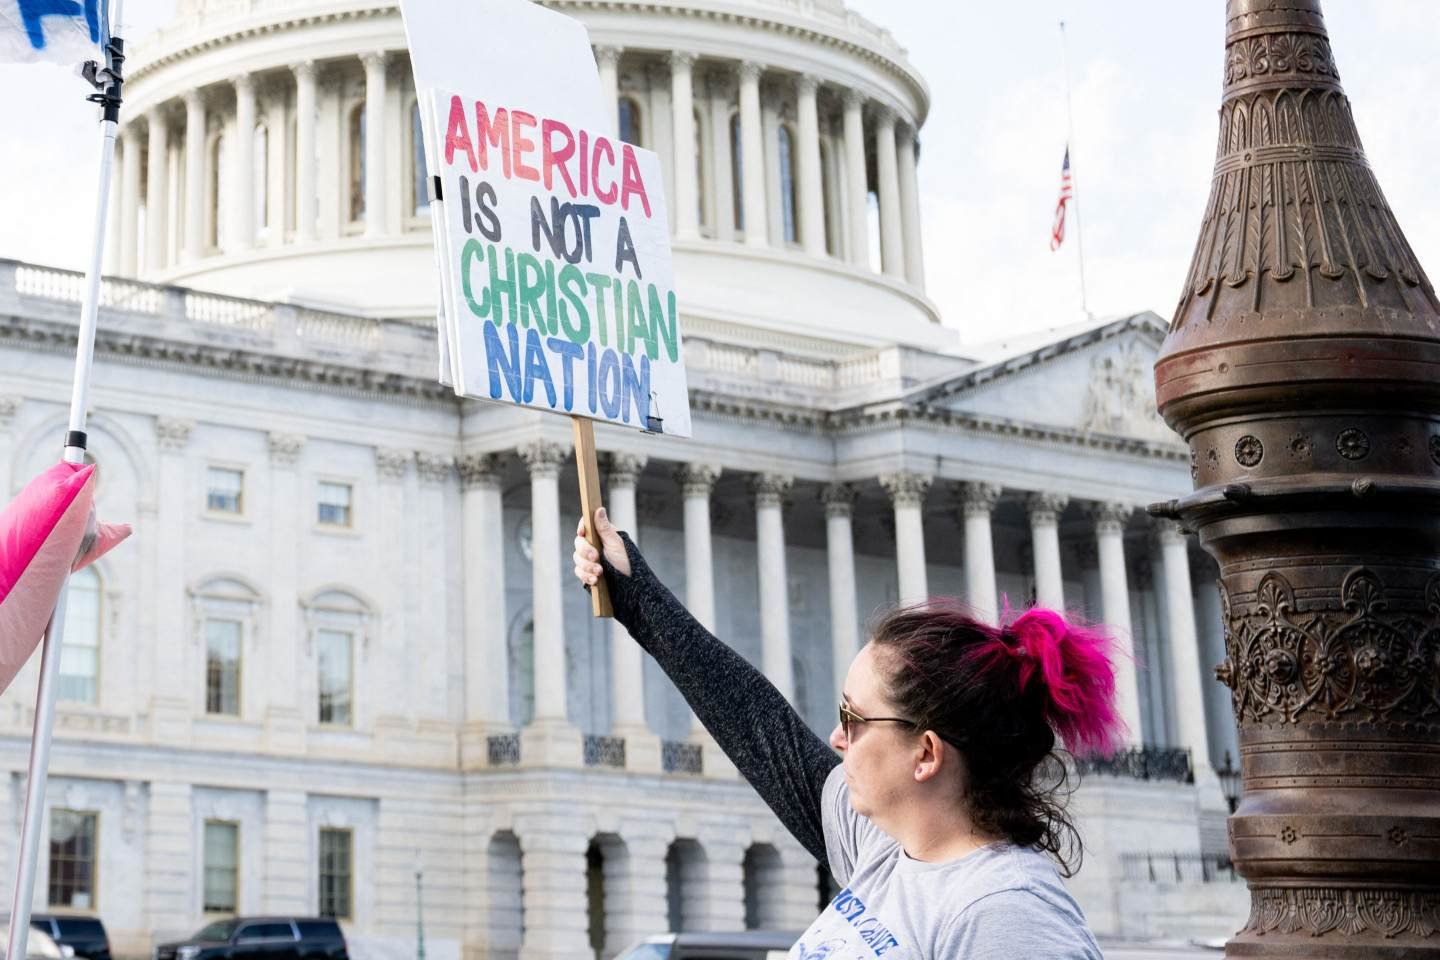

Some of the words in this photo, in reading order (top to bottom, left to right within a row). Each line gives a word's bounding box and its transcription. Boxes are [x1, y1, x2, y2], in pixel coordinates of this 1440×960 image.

[445, 95, 652, 218] AMERICA
[459, 176, 501, 242] IS
[531, 195, 600, 264] NOT
[615, 216, 642, 280] A
[461, 238, 678, 363] CHRISTIAN
[483, 320, 651, 429] NATION
